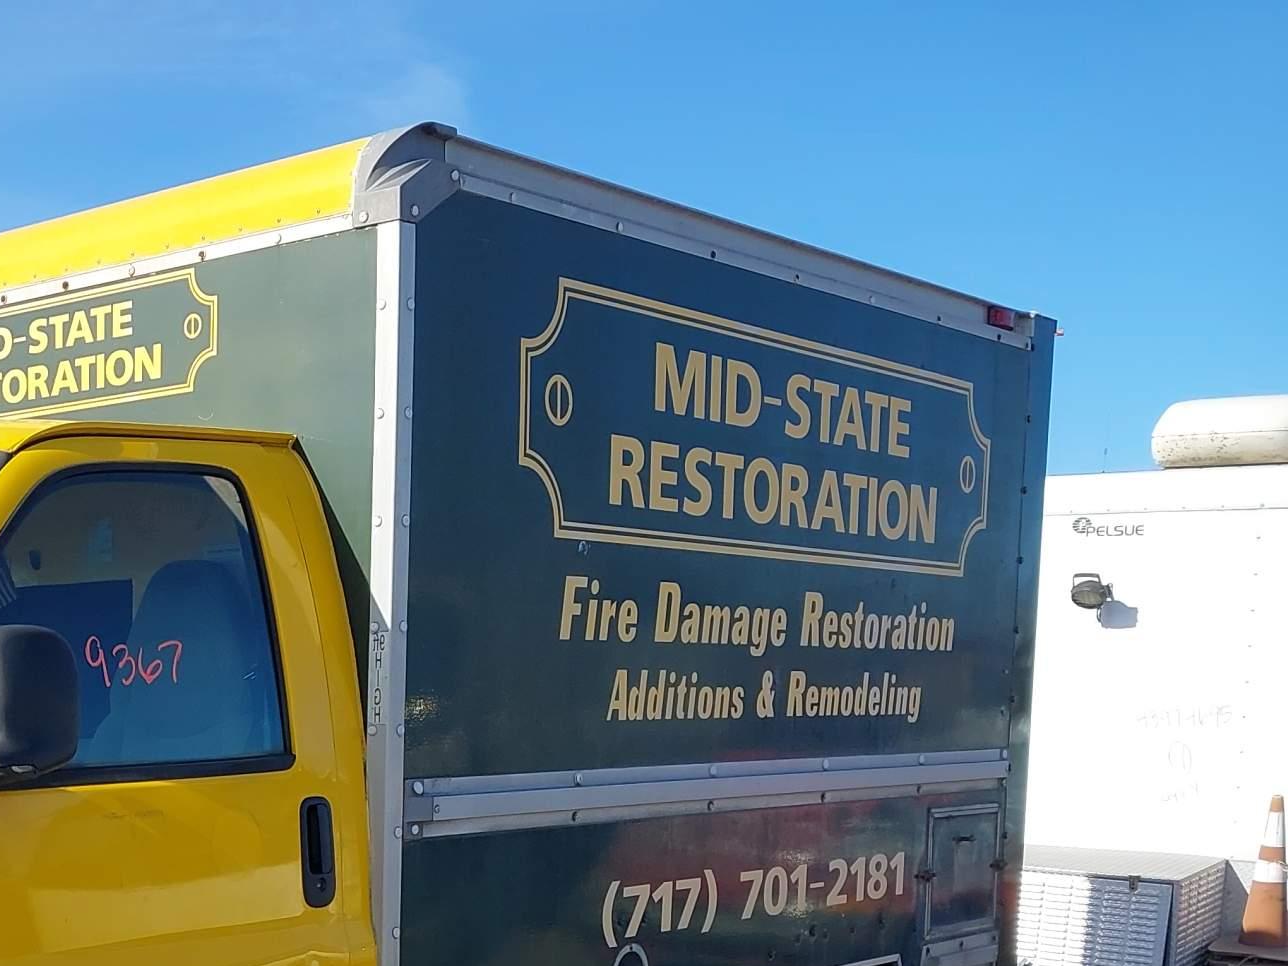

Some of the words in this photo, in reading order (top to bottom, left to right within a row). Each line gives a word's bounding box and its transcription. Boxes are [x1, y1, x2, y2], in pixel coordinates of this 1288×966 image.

[654, 342, 911, 458] MID-STATE
[609, 434, 938, 544] RESTORATION
[1086, 524, 1144, 537] PELSUE
[559, 575, 639, 642] Fire
[654, 581, 787, 657] Damage
[800, 591, 955, 651] Restoration
[84, 635, 183, 688] 9367
[606, 669, 744, 721] Additions
[756, 670, 776, 718] &
[786, 670, 922, 723] Remodeling
[601, 868, 718, 948] (717)
[740, 851, 905, 921] 701-2181
